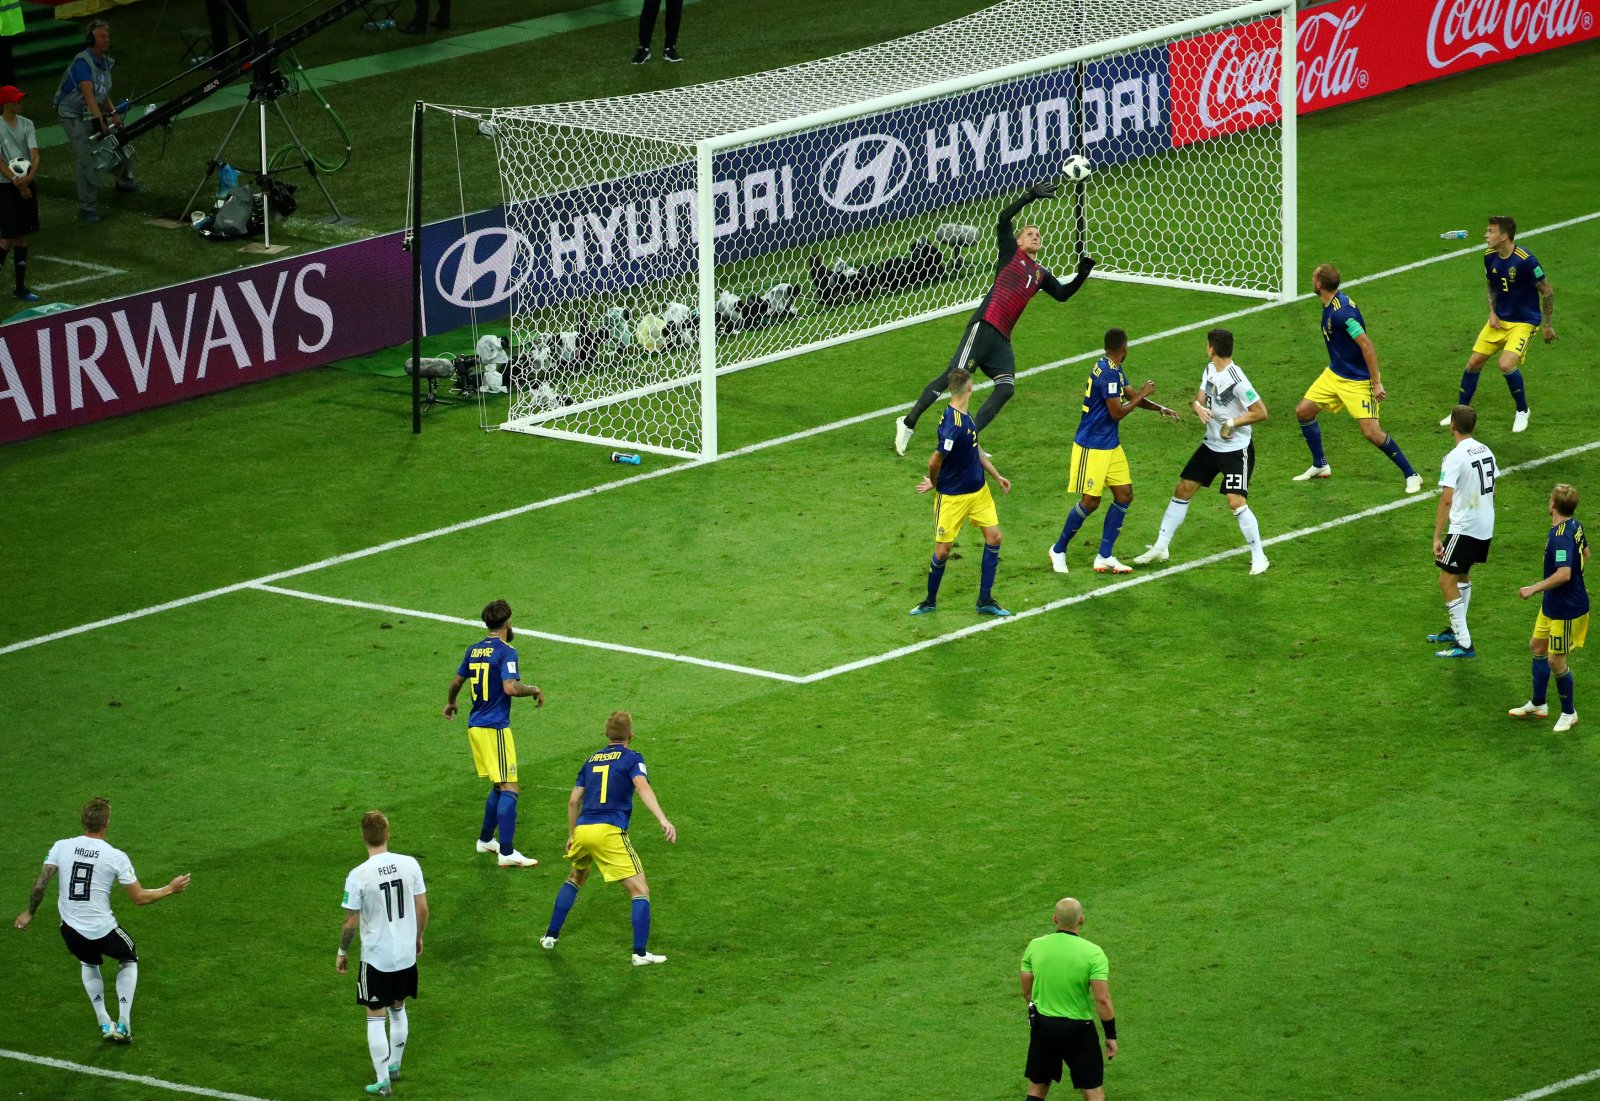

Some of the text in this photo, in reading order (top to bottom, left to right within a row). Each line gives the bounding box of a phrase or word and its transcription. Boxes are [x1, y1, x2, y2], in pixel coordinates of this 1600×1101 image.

[1198, 35, 1279, 128] Coca
[926, 73, 1160, 184] HYUNDAI
[550, 164, 794, 279] HYUNDAI
[1501, 277, 1509, 292] 3
[0, 262, 335, 423] AIRWAYS
[1515, 338, 1526, 353] 3
[1361, 400, 1371, 414] 4
[1225, 473, 1243, 490] 23
[1471, 456, 1496, 496] 13
[468, 662, 490, 702] 21
[592, 764, 610, 804] 7
[68, 861, 95, 902] 8
[377, 863, 398, 877] REUS
[379, 878, 405, 923] 11
